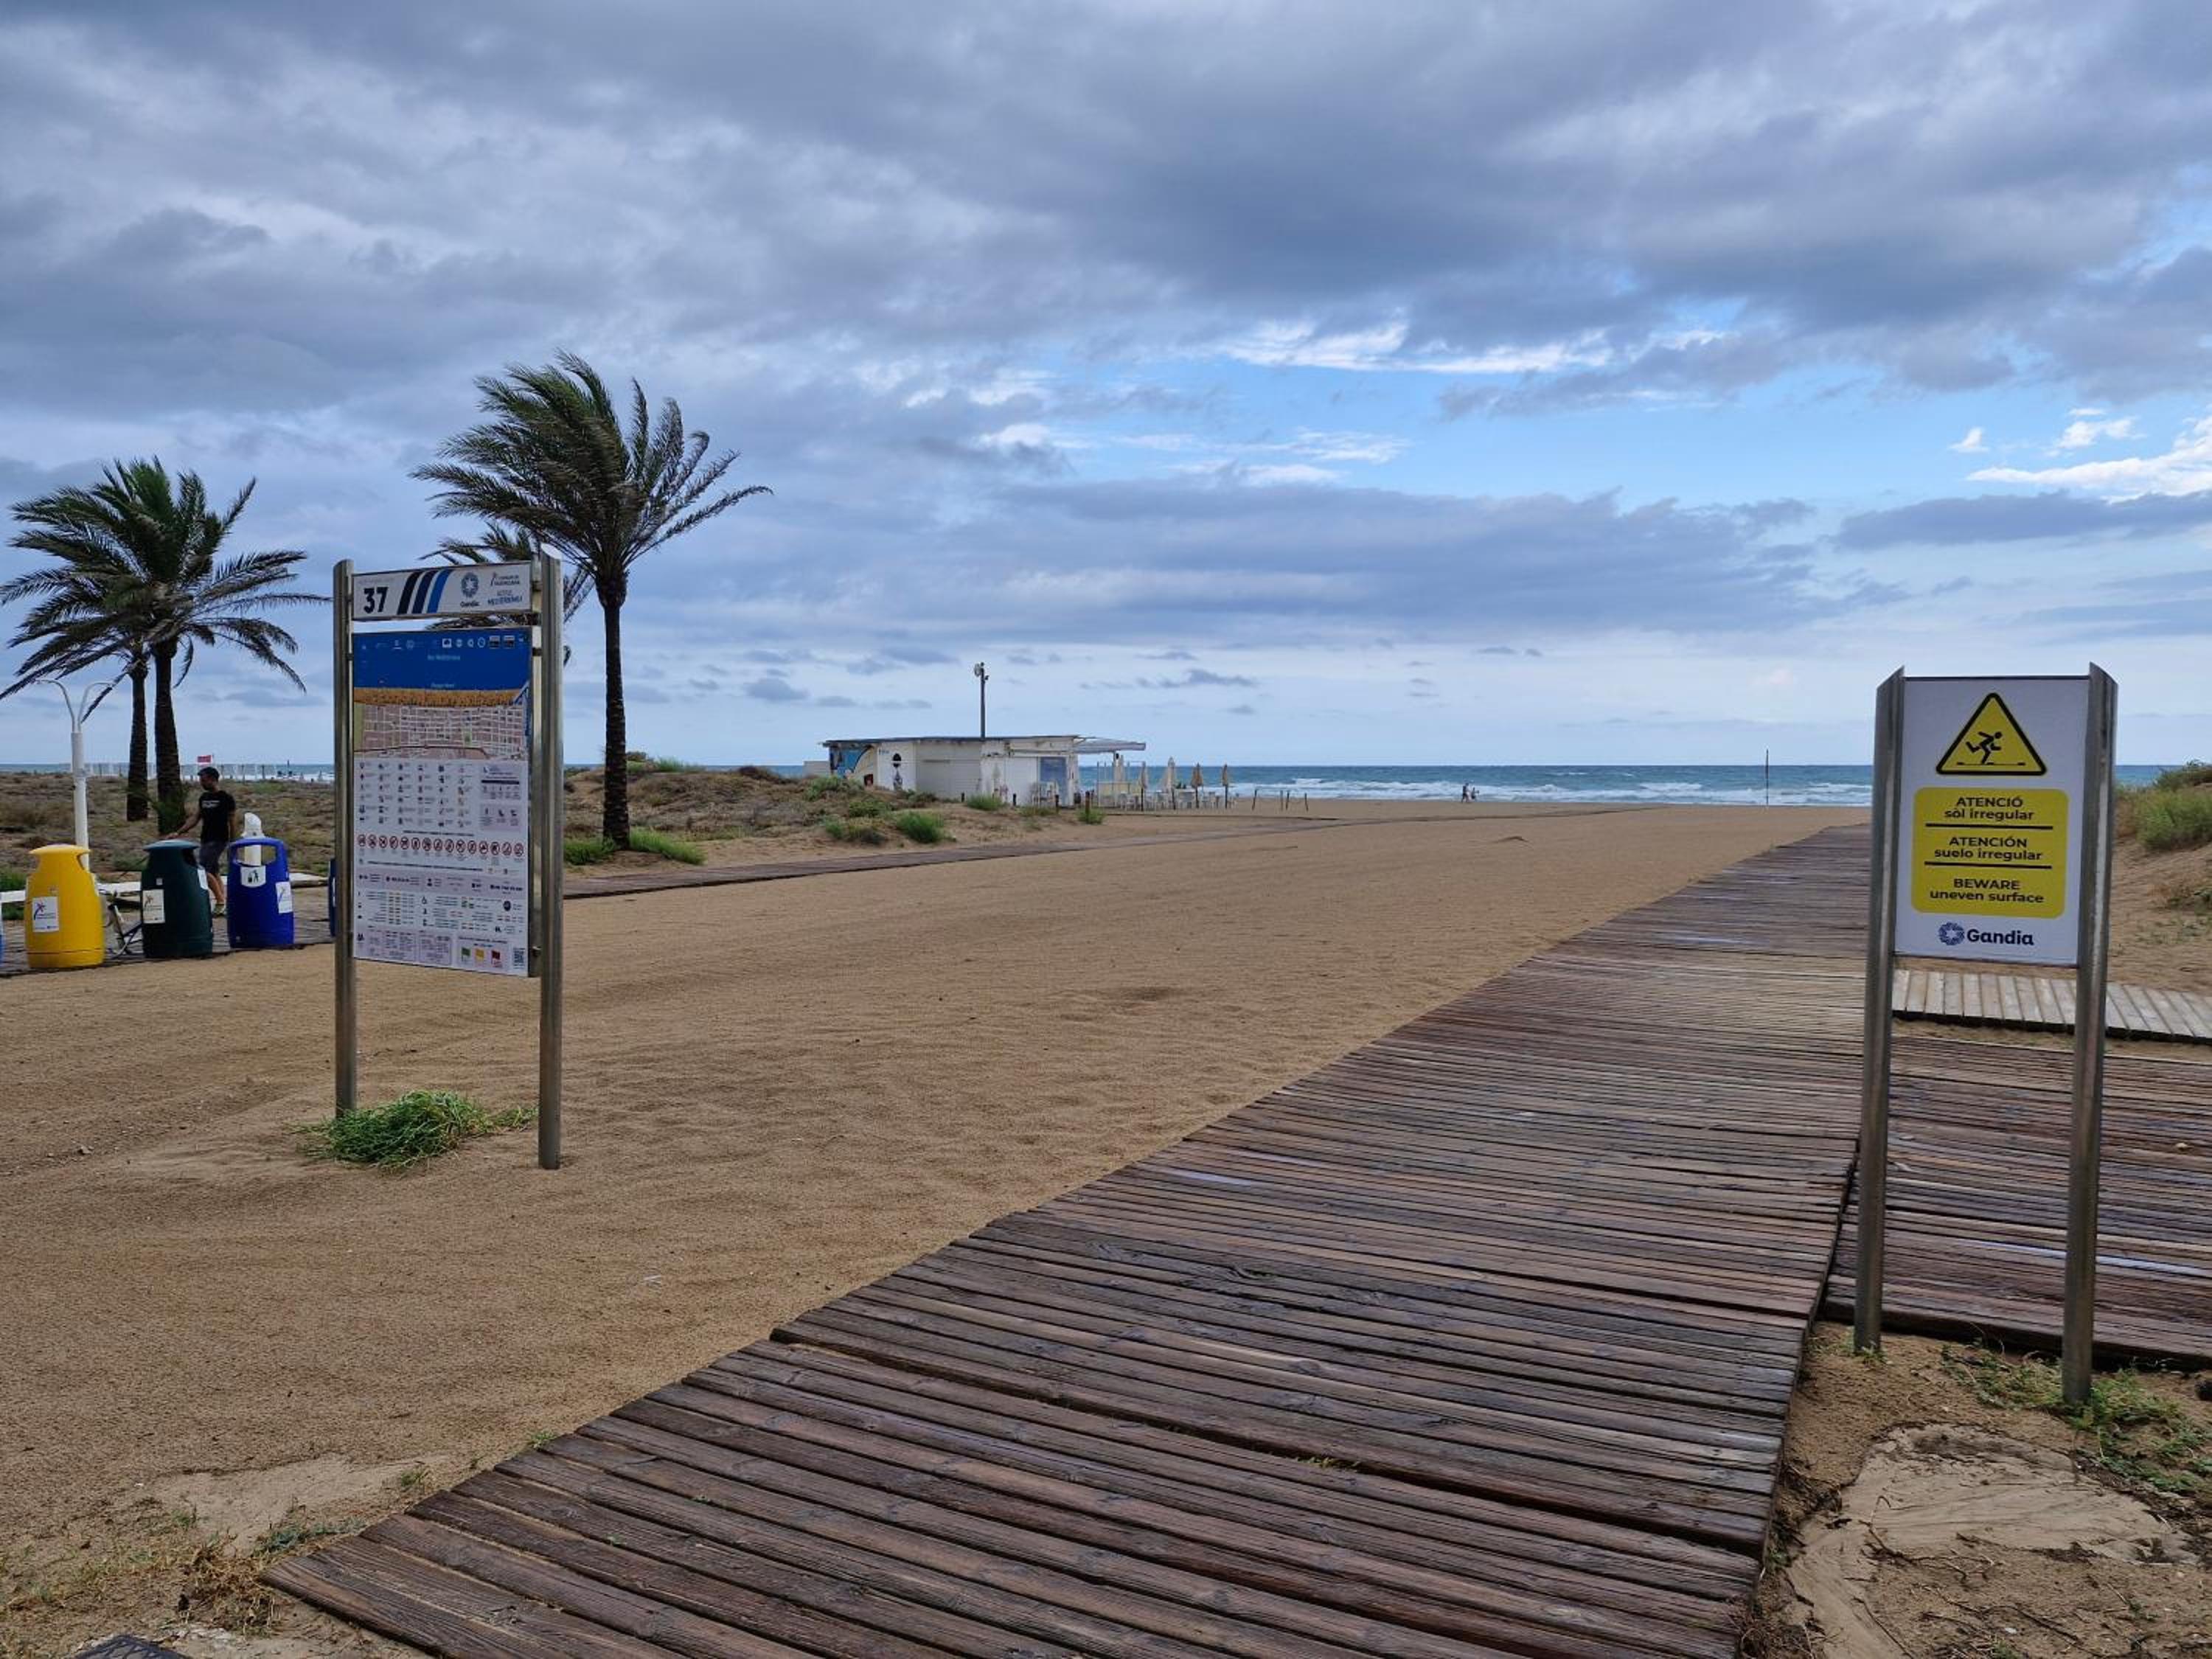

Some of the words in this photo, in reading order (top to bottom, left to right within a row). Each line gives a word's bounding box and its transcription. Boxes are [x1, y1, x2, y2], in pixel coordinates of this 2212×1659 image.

[364, 586, 389, 613] 37
[1956, 795, 2023, 807] ATENCIÓ
[1969, 809, 2035, 821] irregular
[1949, 835, 2028, 848] ATENCIÓN
[1934, 849, 1973, 858] suelo
[1978, 849, 2042, 862] irregular
[1953, 877, 2020, 890] BEWARE
[1930, 890, 1984, 900] uneven
[1988, 891, 2045, 903] surface
[1966, 928, 2034, 946] Gandia
